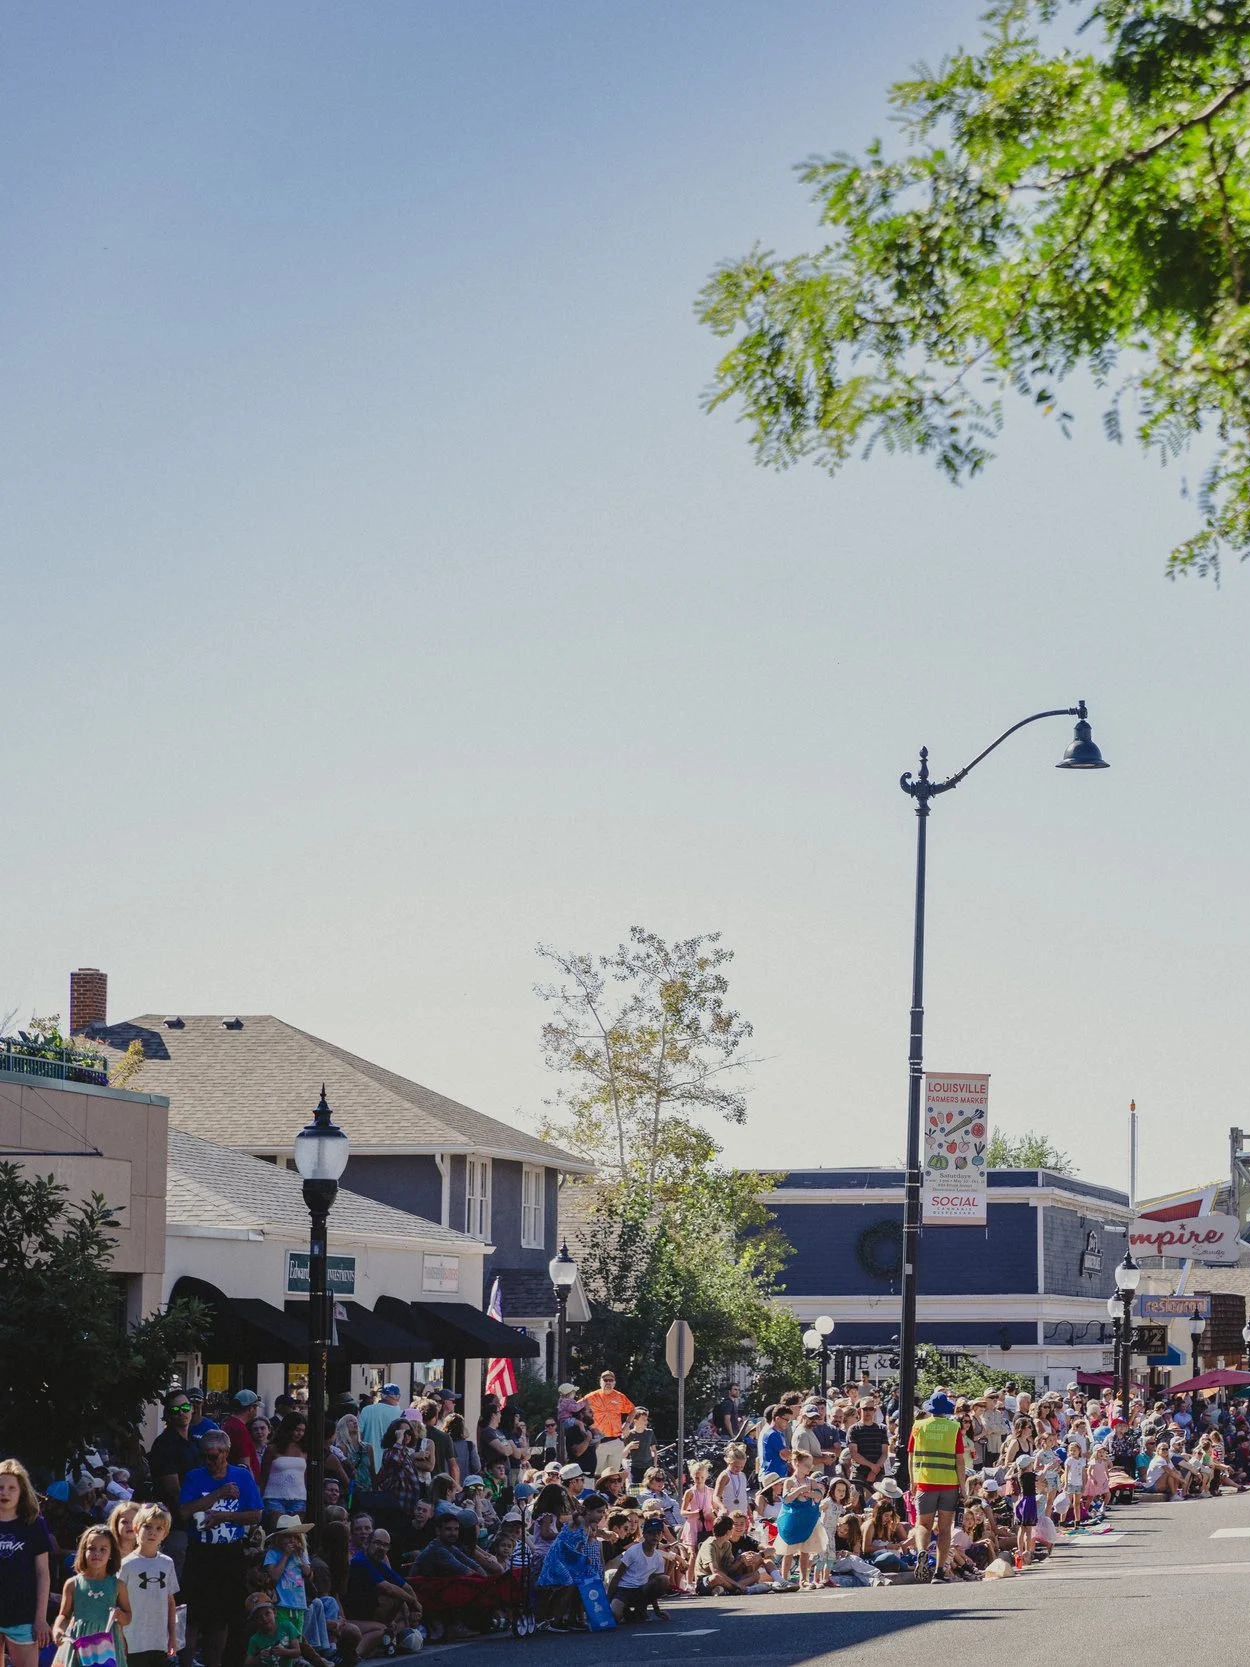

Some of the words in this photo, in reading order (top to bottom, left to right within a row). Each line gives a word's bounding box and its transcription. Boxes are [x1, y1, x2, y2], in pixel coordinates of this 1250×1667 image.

[928, 1082, 986, 1094] LOUISVILLE
[928, 1095, 959, 1103] FARMERS
[931, 1196, 979, 1207] SOCIAL
[1129, 1224, 1225, 1255] mpire
